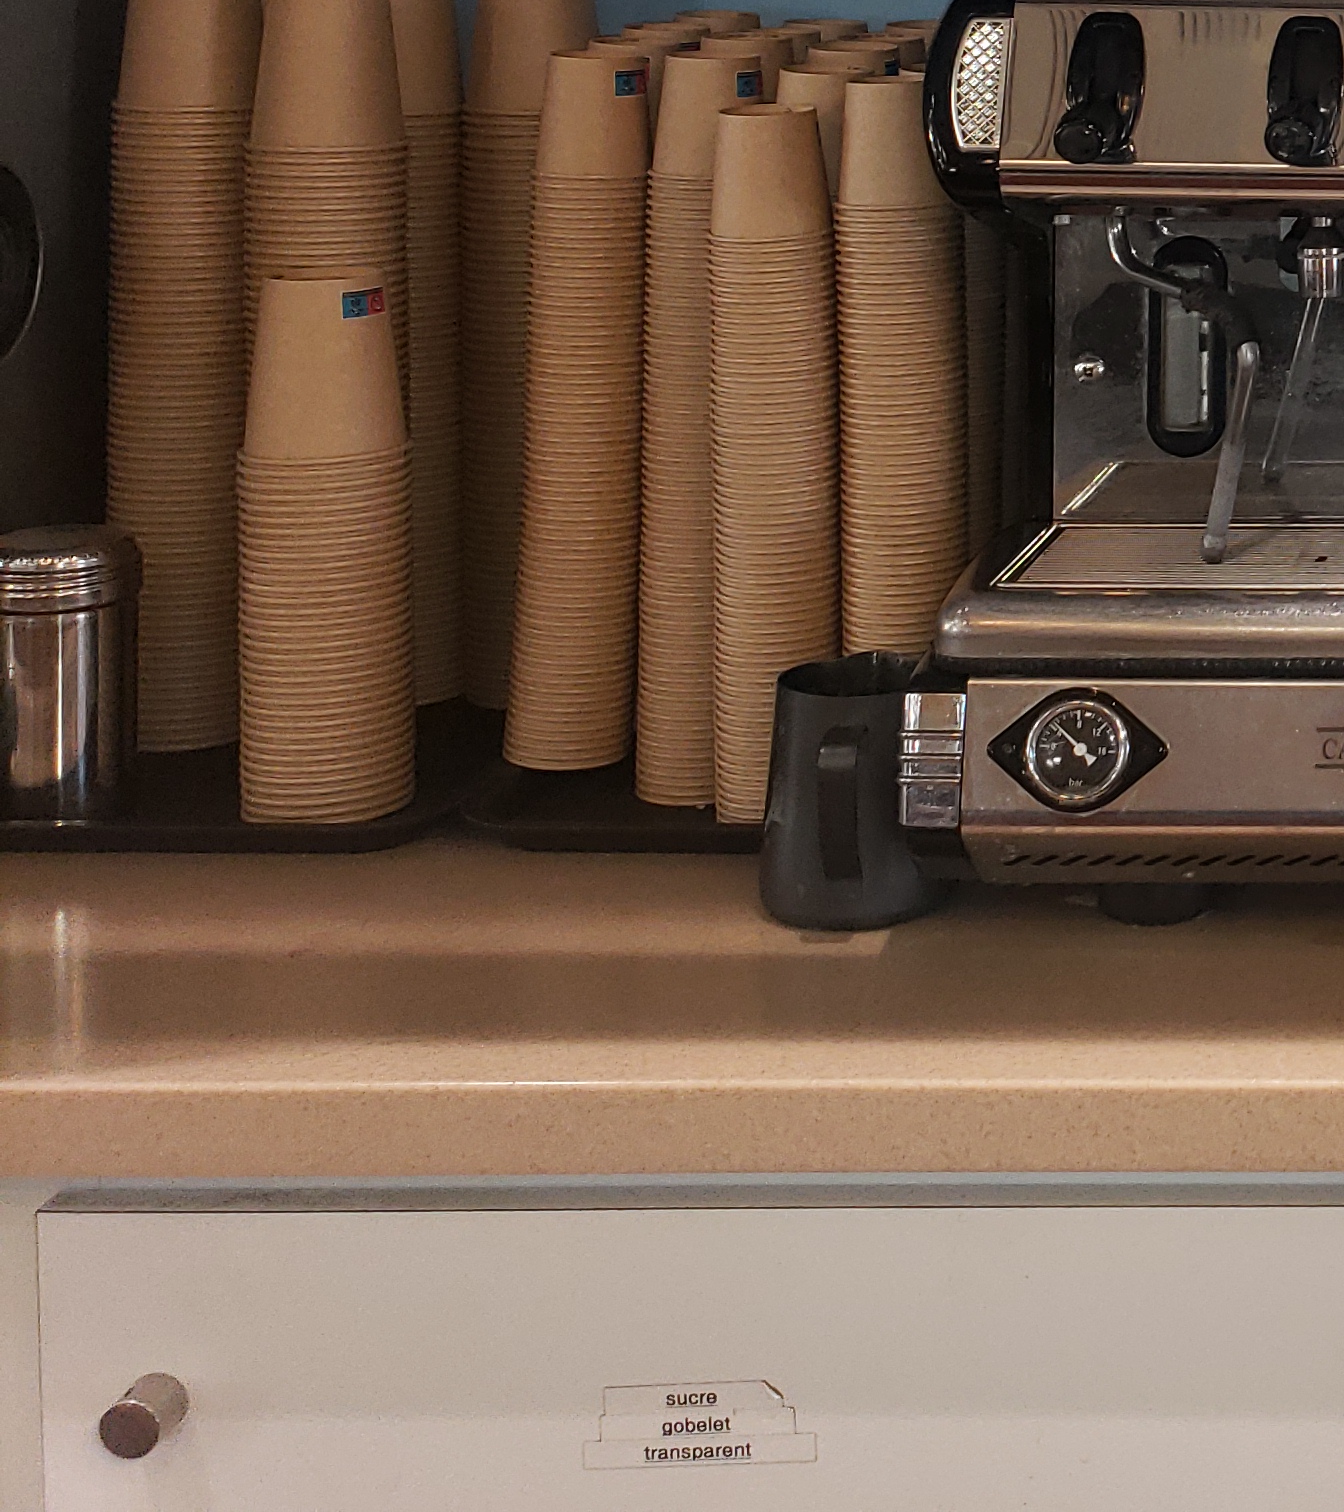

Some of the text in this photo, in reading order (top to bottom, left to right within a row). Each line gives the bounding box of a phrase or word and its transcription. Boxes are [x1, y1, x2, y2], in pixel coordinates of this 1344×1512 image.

[666, 1391, 718, 1407] sucre
[661, 1415, 732, 1436] gobelet
[643, 1442, 752, 1461] transparent
